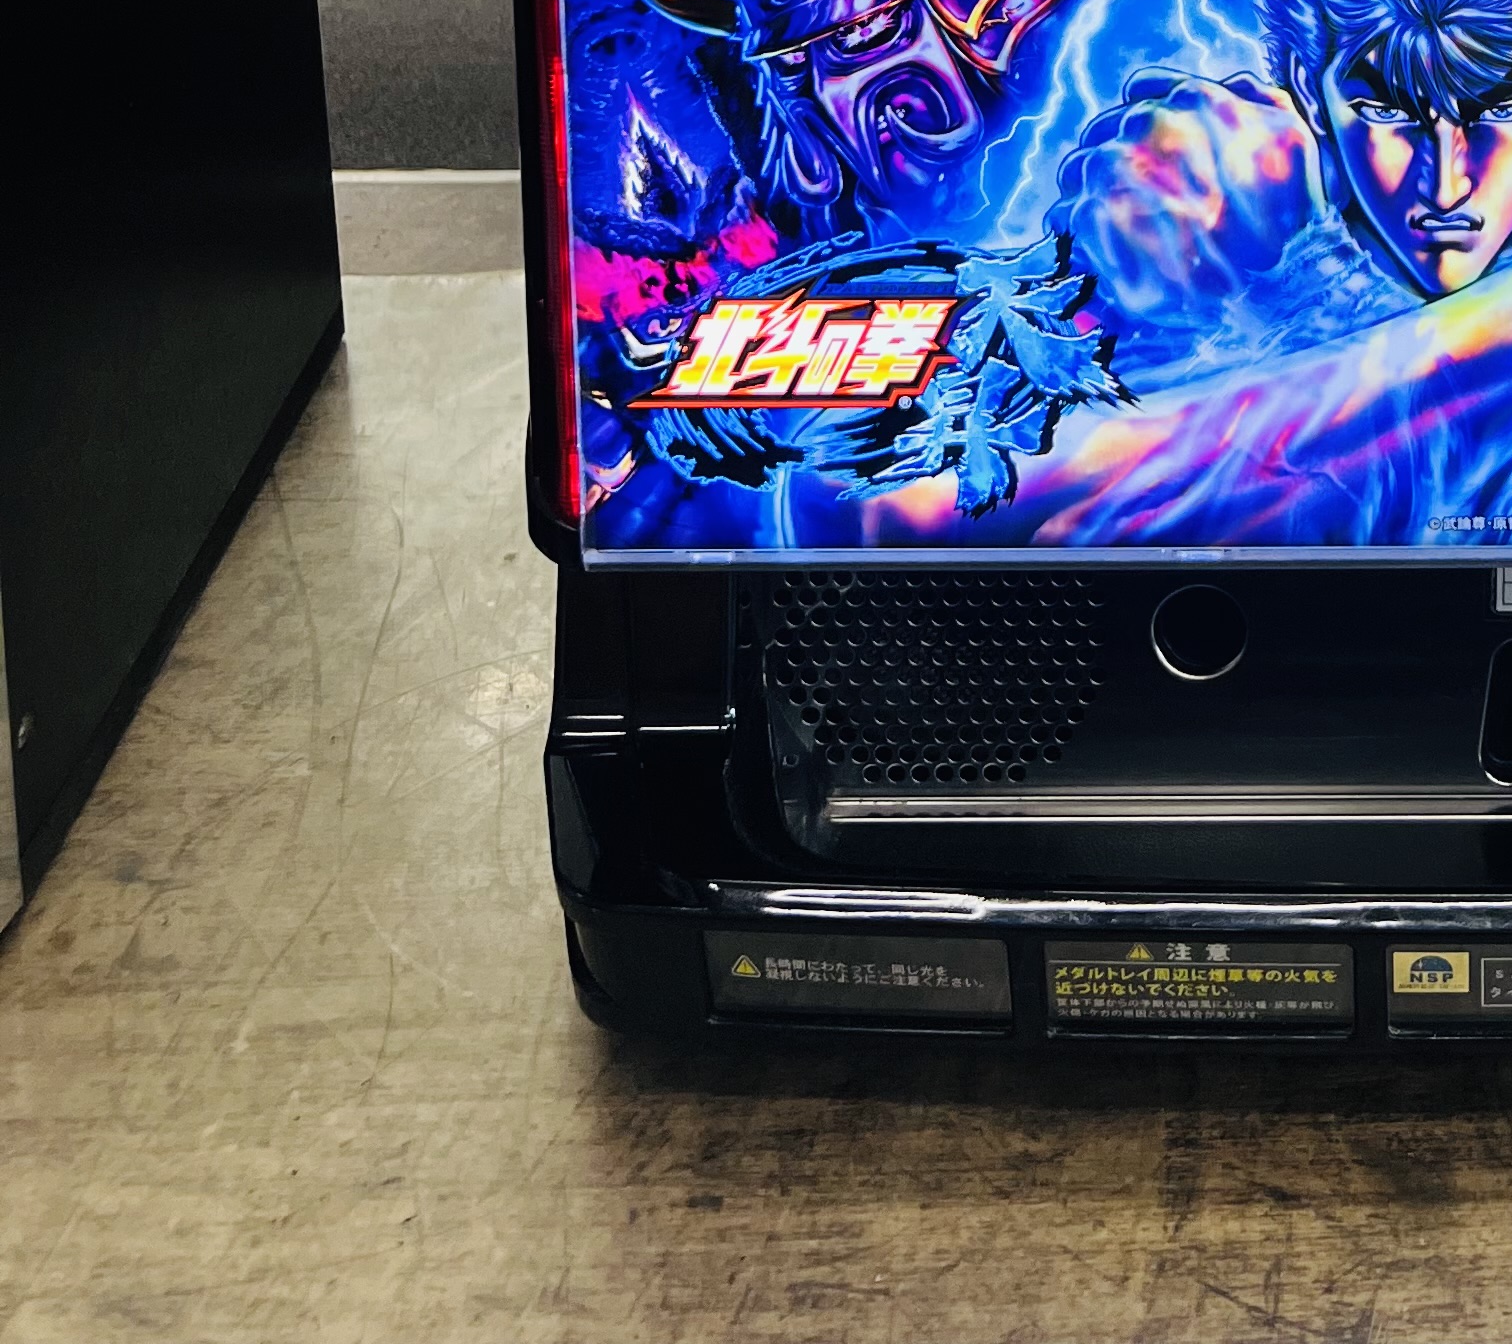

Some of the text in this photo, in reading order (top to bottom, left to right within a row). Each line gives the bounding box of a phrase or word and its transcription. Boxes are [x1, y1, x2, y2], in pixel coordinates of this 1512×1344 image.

[660, 292, 952, 396] 北斗の拳
[1165, 942, 1231, 961] 注意
[1409, 972, 1454, 983] NSP
